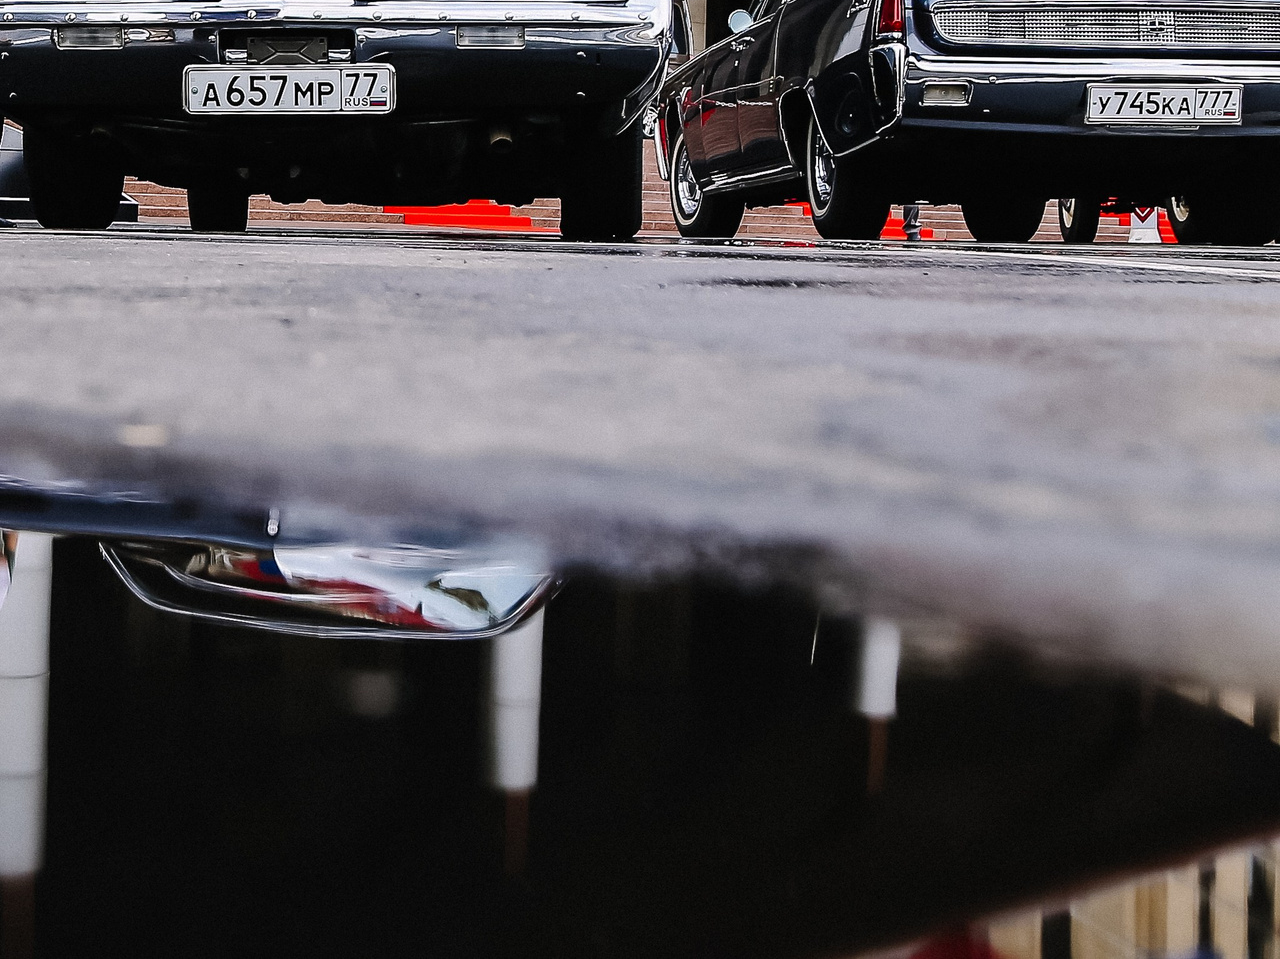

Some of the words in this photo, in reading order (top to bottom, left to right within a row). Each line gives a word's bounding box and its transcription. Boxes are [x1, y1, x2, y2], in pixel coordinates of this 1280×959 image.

[345, 72, 379, 97] 77
[344, 97, 370, 107] RUS
[1197, 90, 1233, 109] 777
